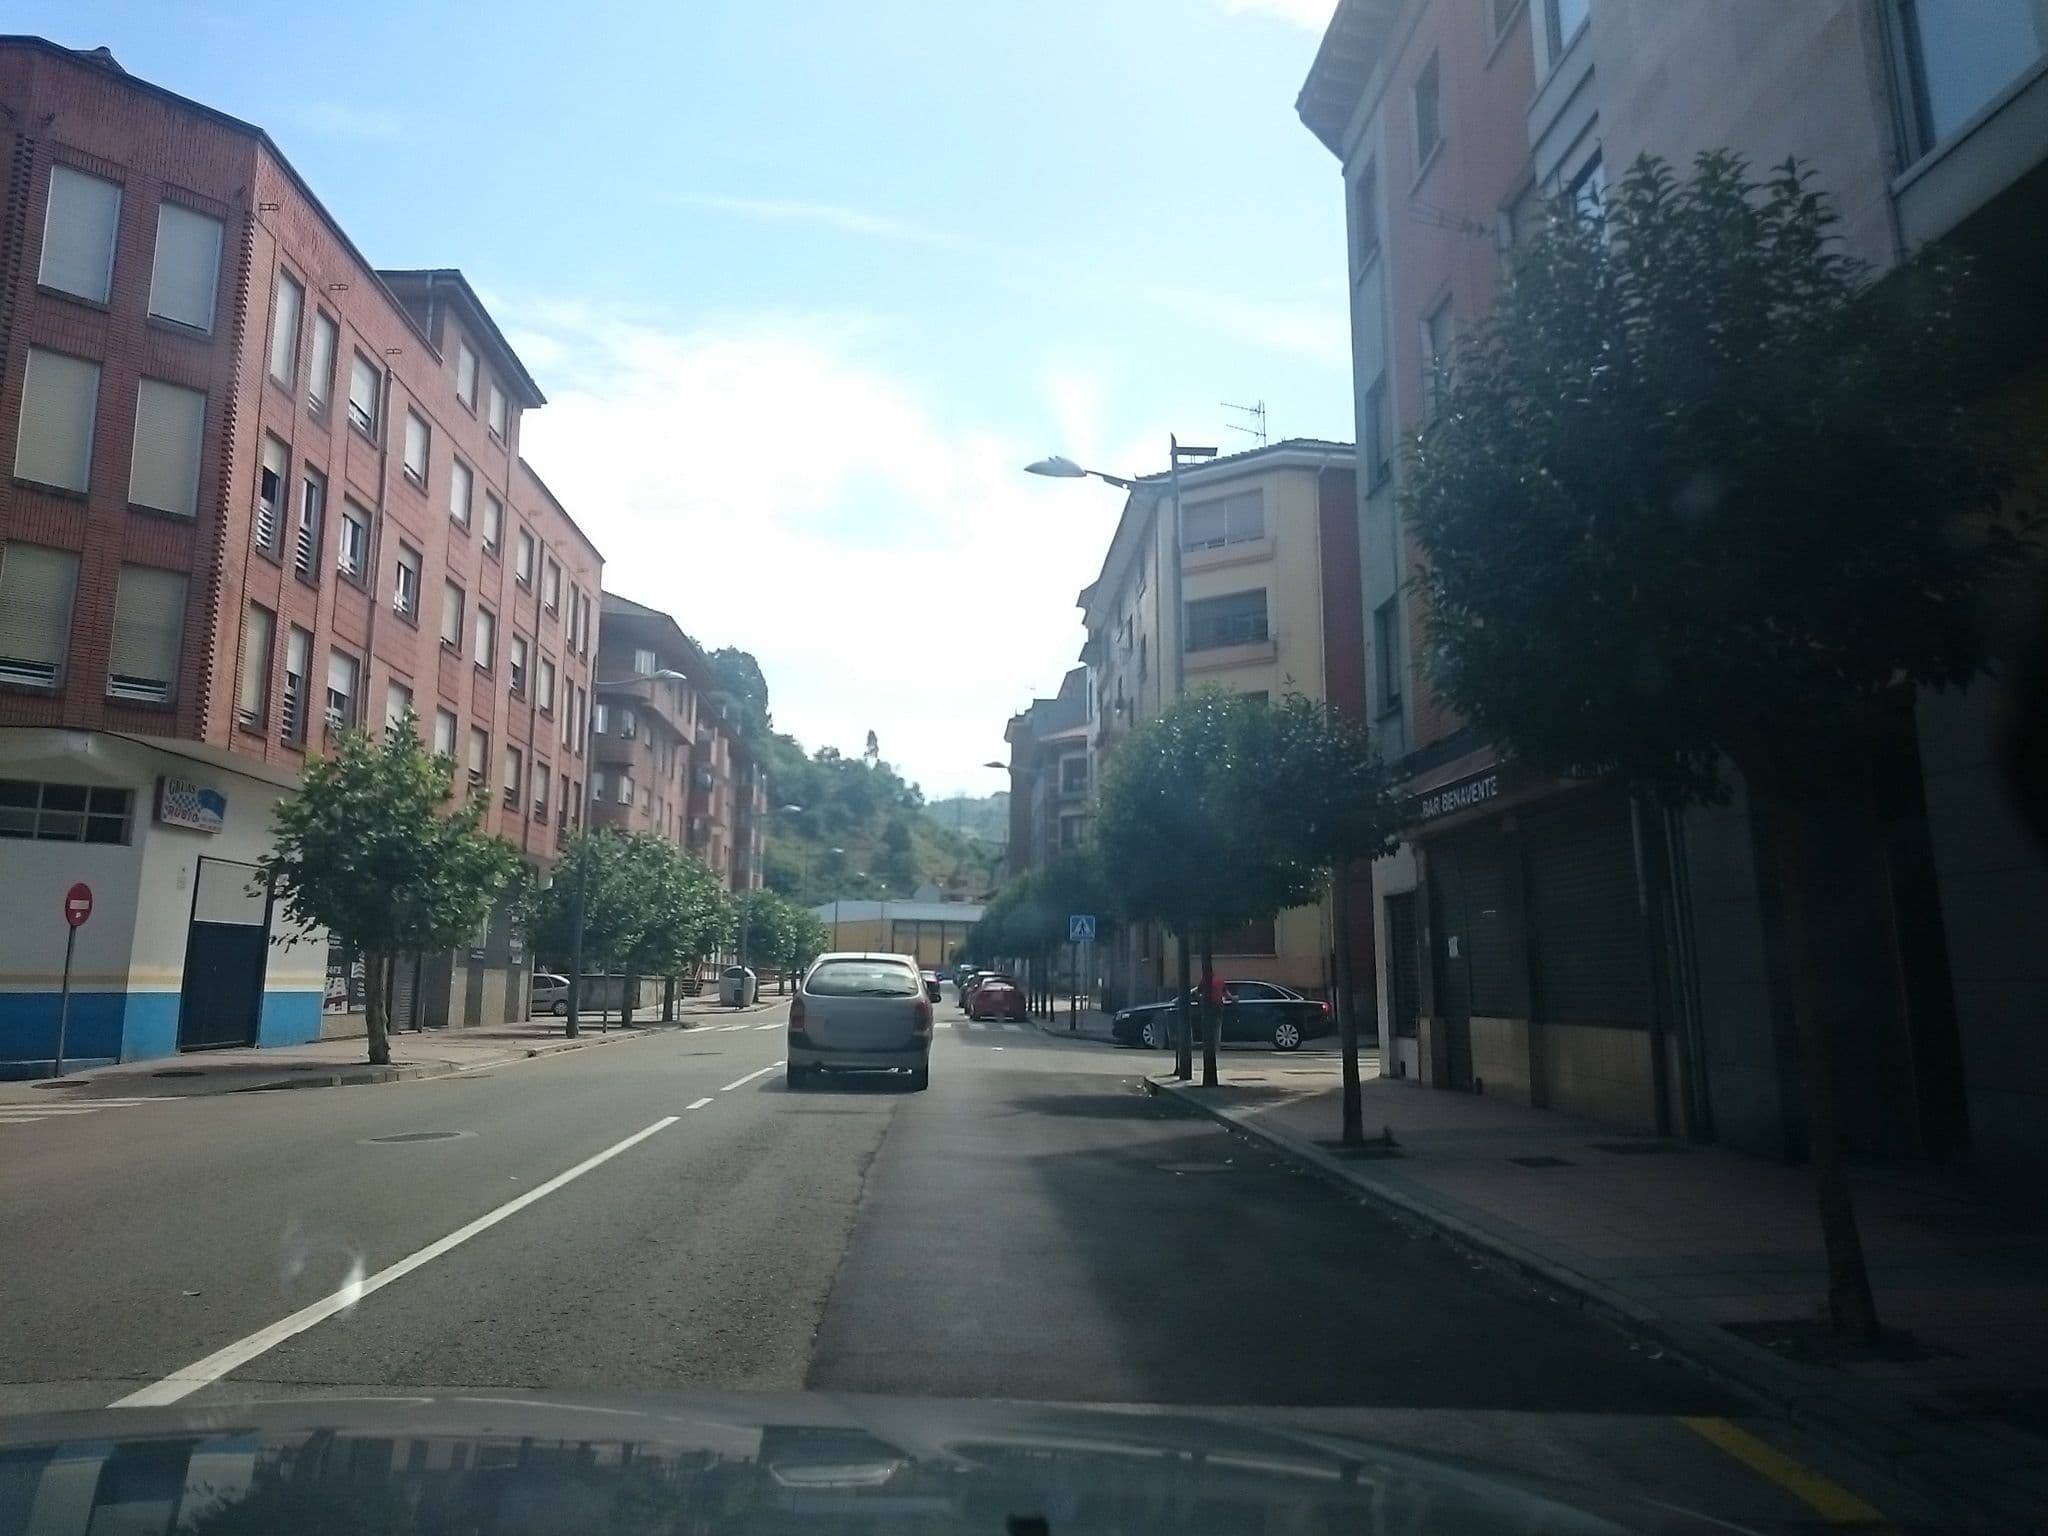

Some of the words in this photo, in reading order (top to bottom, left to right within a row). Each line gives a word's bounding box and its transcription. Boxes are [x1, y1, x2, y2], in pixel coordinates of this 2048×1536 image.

[1422, 796, 1440, 818] BAR
[1441, 775, 1498, 812] BENAVENTE
[167, 805, 199, 822] RUBIO
